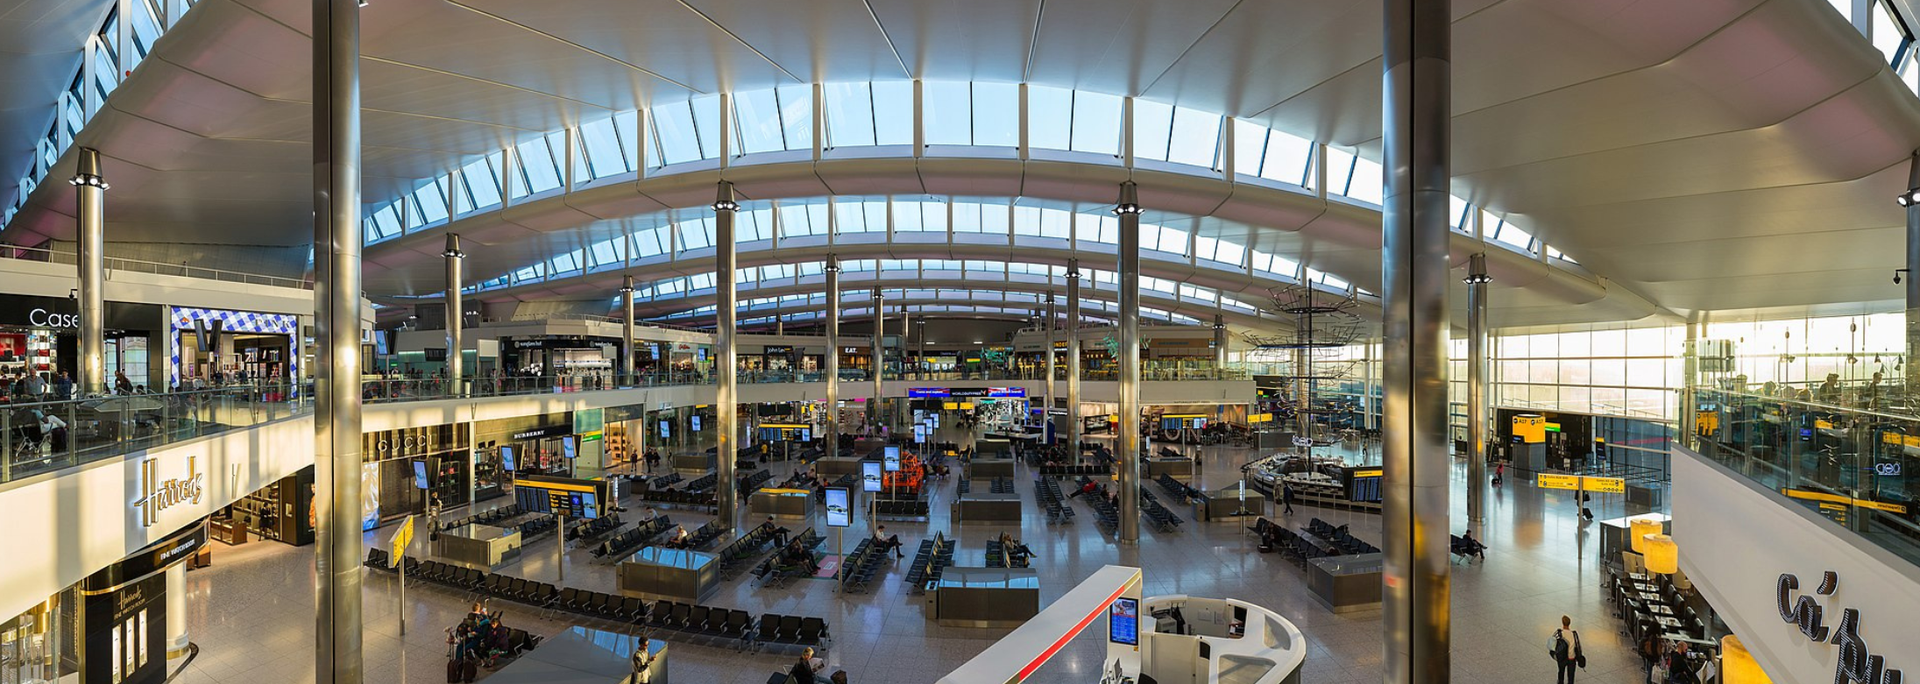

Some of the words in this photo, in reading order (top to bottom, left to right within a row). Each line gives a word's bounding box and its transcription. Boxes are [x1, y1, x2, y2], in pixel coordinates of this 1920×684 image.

[30, 308, 79, 328] Case
[378, 434, 432, 452] GUCCI
[134, 455, 202, 527] Harrods
